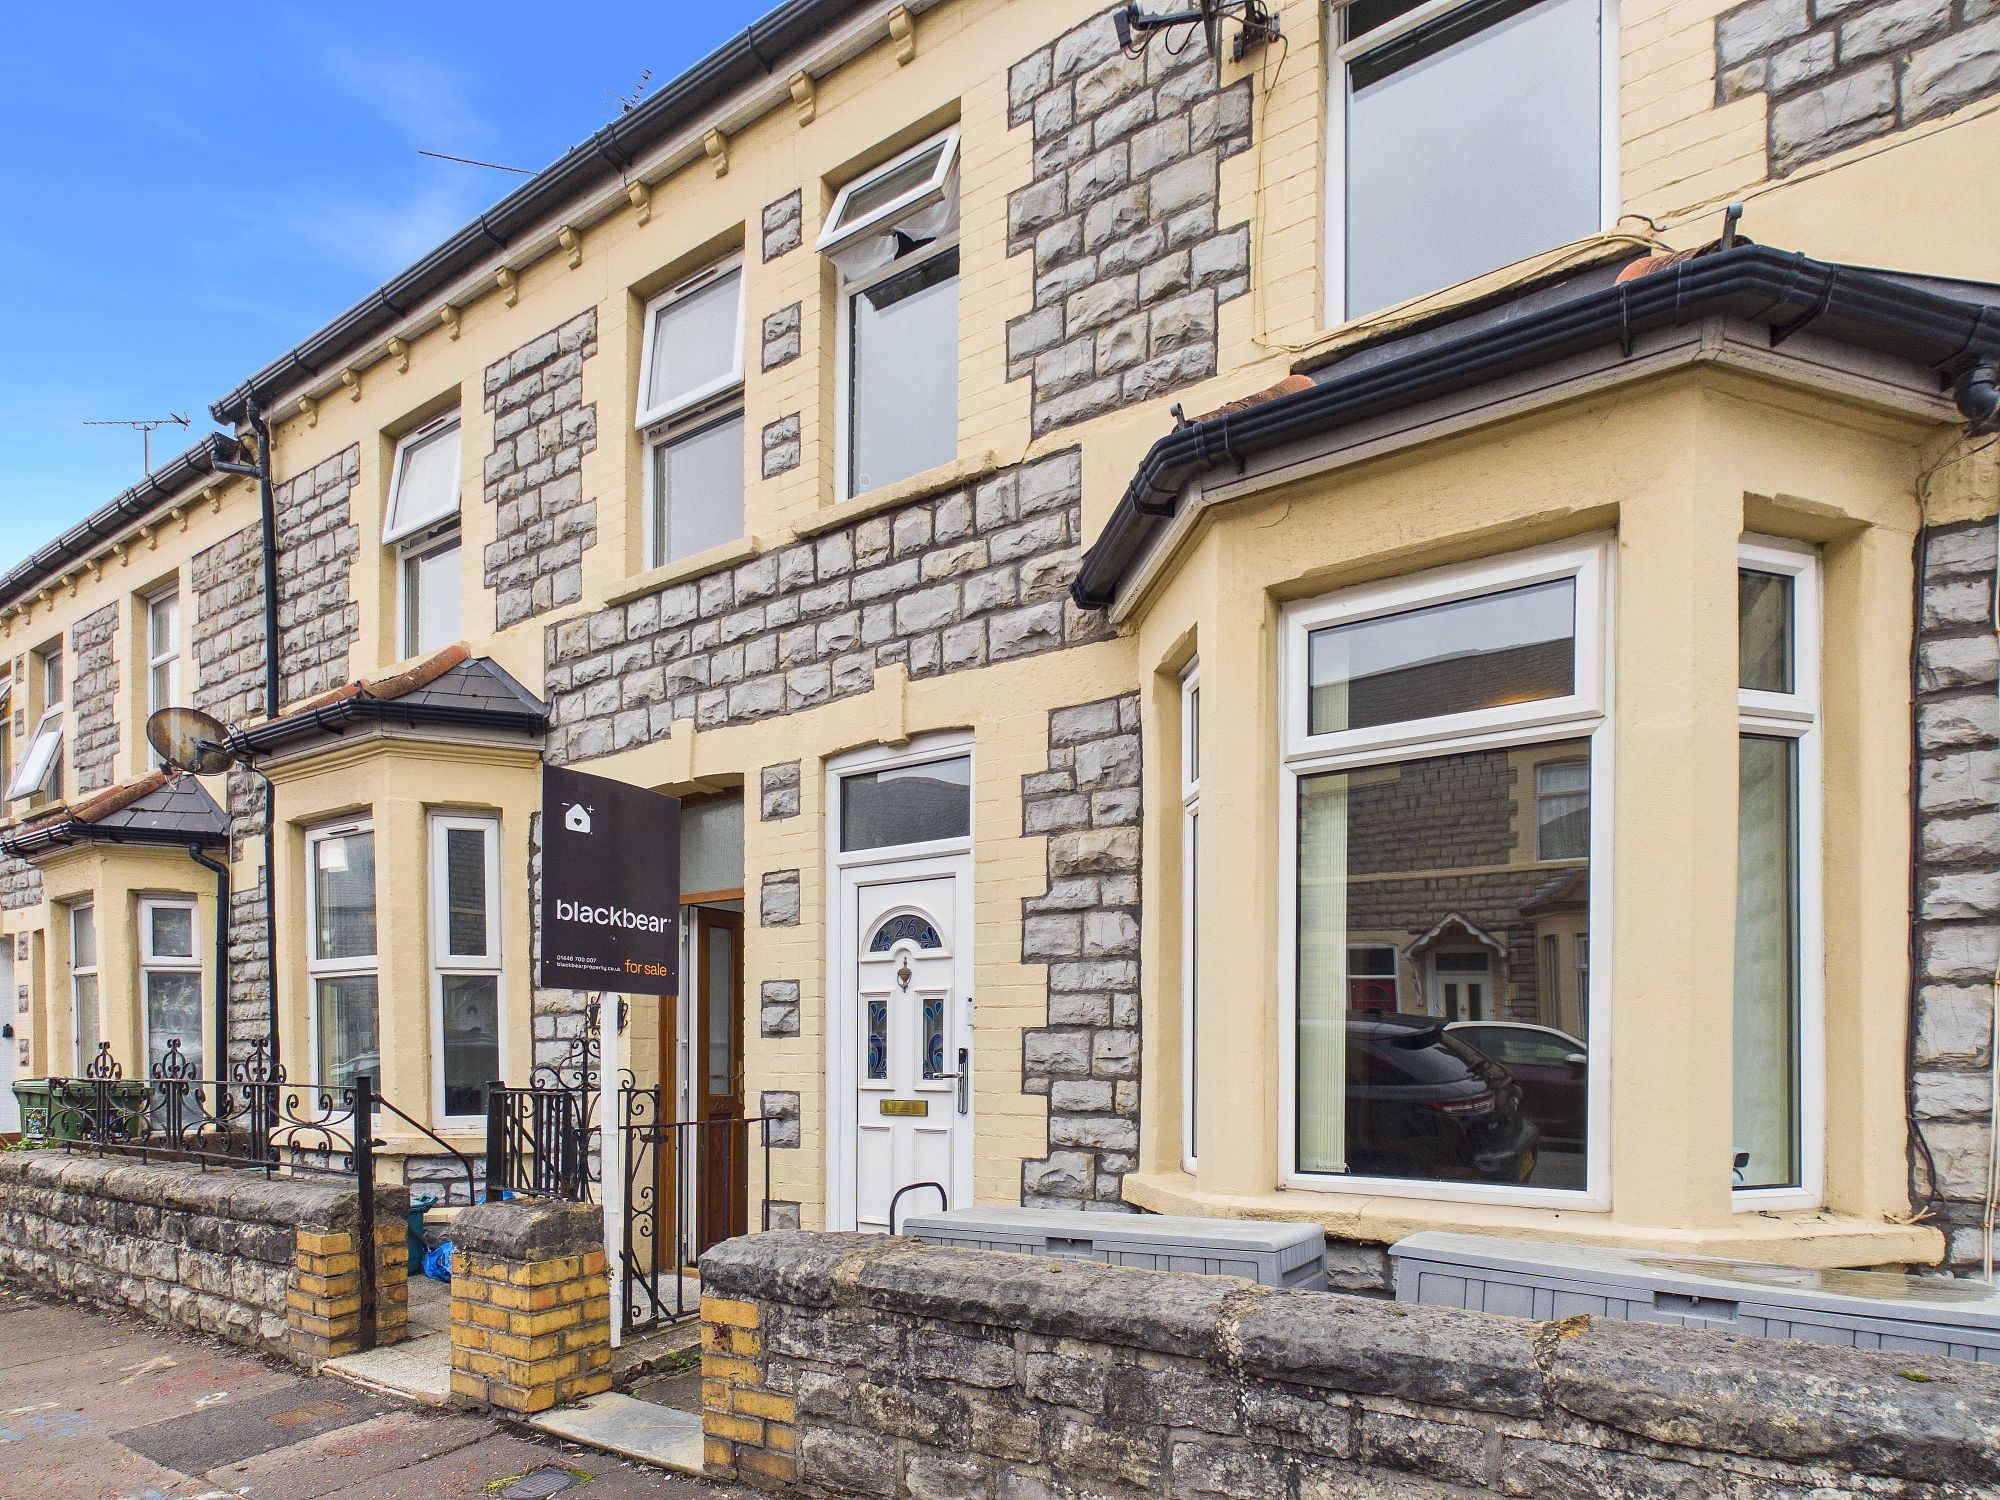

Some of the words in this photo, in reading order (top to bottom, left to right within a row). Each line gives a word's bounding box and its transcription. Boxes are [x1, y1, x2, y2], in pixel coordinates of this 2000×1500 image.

[556, 899, 669, 934] blackbear
[895, 918, 917, 938] 26
[556, 962, 621, 972] blackbearproperty.co.uk
[625, 959, 643, 974] for
[644, 963, 667, 977] sale
